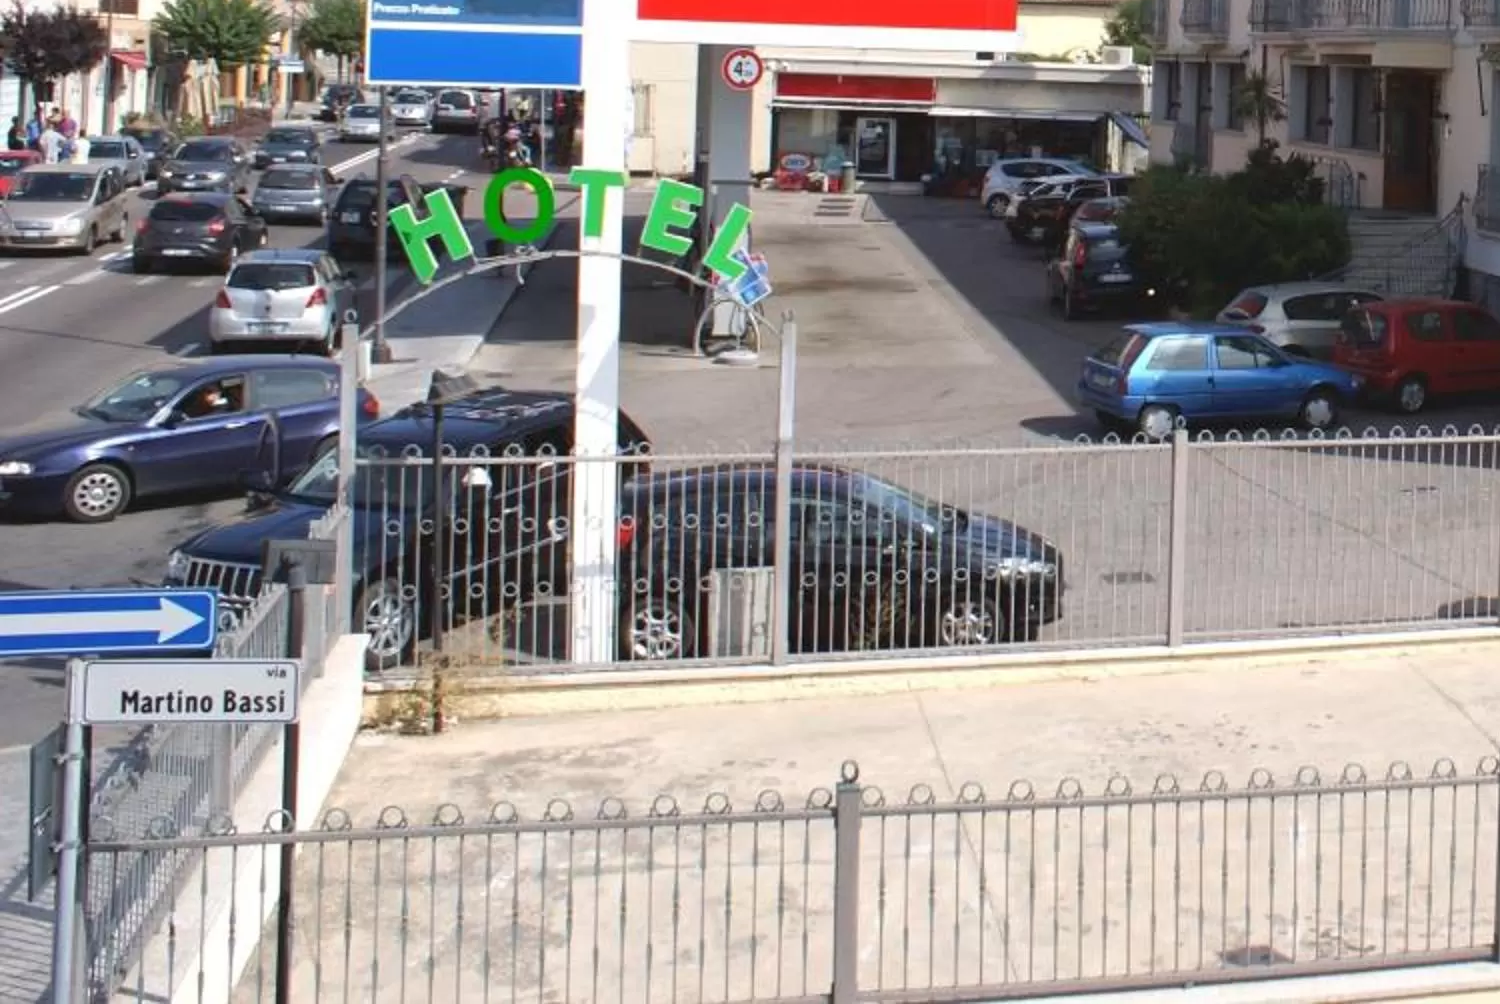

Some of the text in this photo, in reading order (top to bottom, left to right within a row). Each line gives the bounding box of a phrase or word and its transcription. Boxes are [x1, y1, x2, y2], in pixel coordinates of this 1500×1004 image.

[388, 165, 754, 286] HOTEL
[266, 666, 287, 678] via
[120, 689, 286, 714] Martino Bassi
